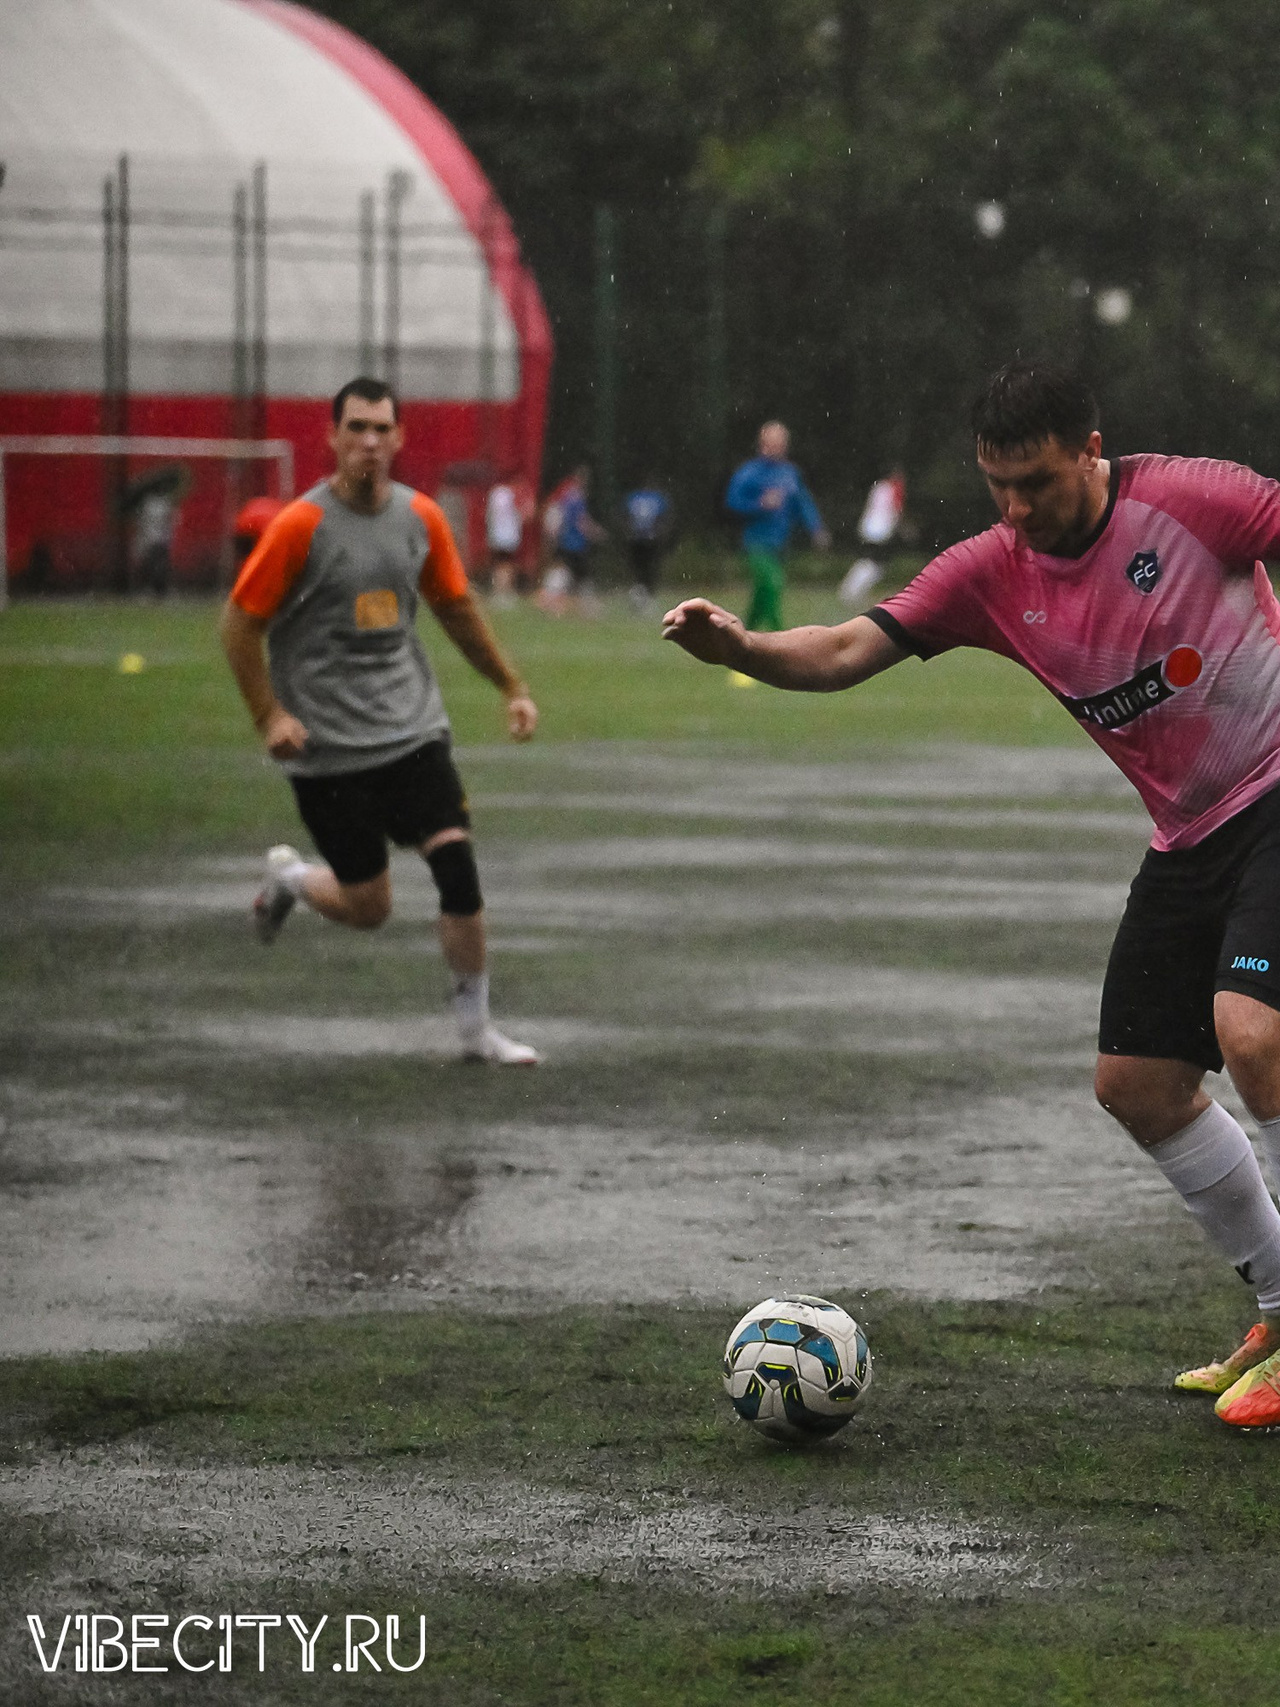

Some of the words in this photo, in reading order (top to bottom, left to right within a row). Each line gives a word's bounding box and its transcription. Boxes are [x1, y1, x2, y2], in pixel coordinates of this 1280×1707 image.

[1133, 561, 1157, 585] FC
[1084, 679, 1160, 724] inline
[1230, 956, 1270, 972] JAKO
